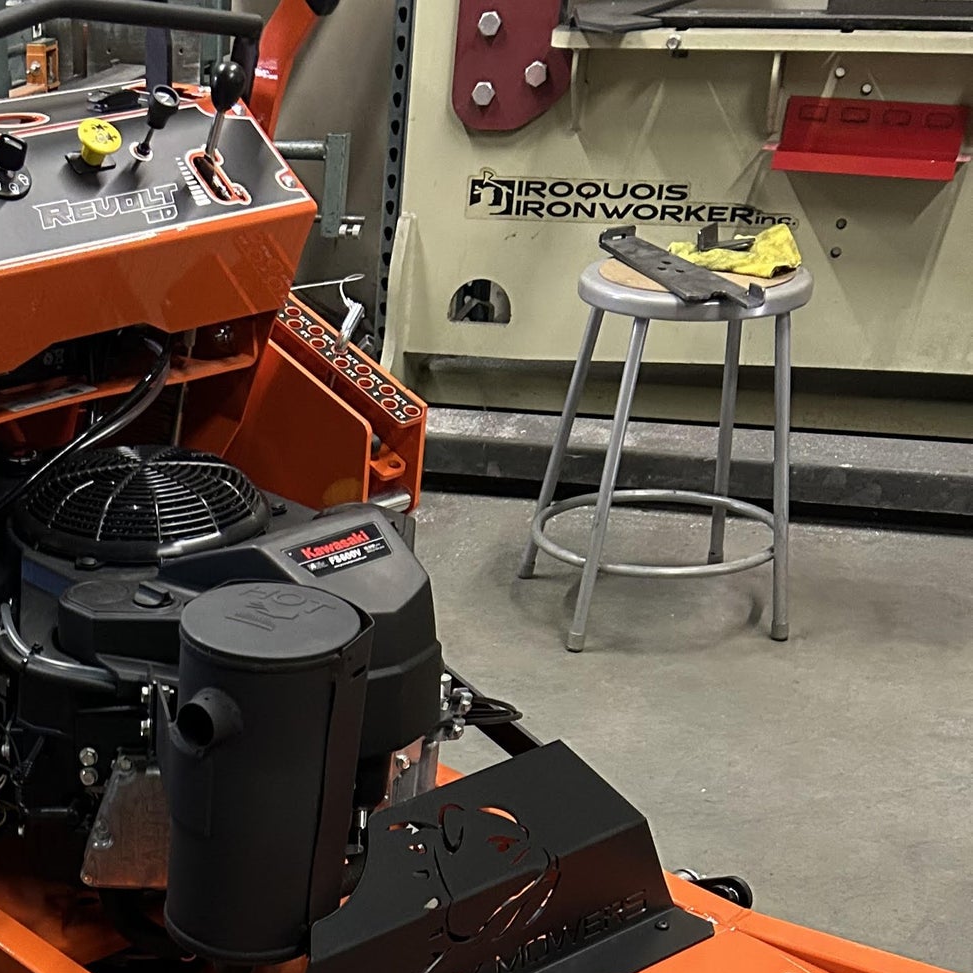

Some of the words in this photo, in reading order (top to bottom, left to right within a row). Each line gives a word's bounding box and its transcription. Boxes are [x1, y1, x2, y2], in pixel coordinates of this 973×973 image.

[516, 180, 689, 201] IROQUOIS
[514, 200, 756, 225] IRONWORKER
[755, 212, 797, 226] inc.
[301, 530, 370, 560] Kawasaki
